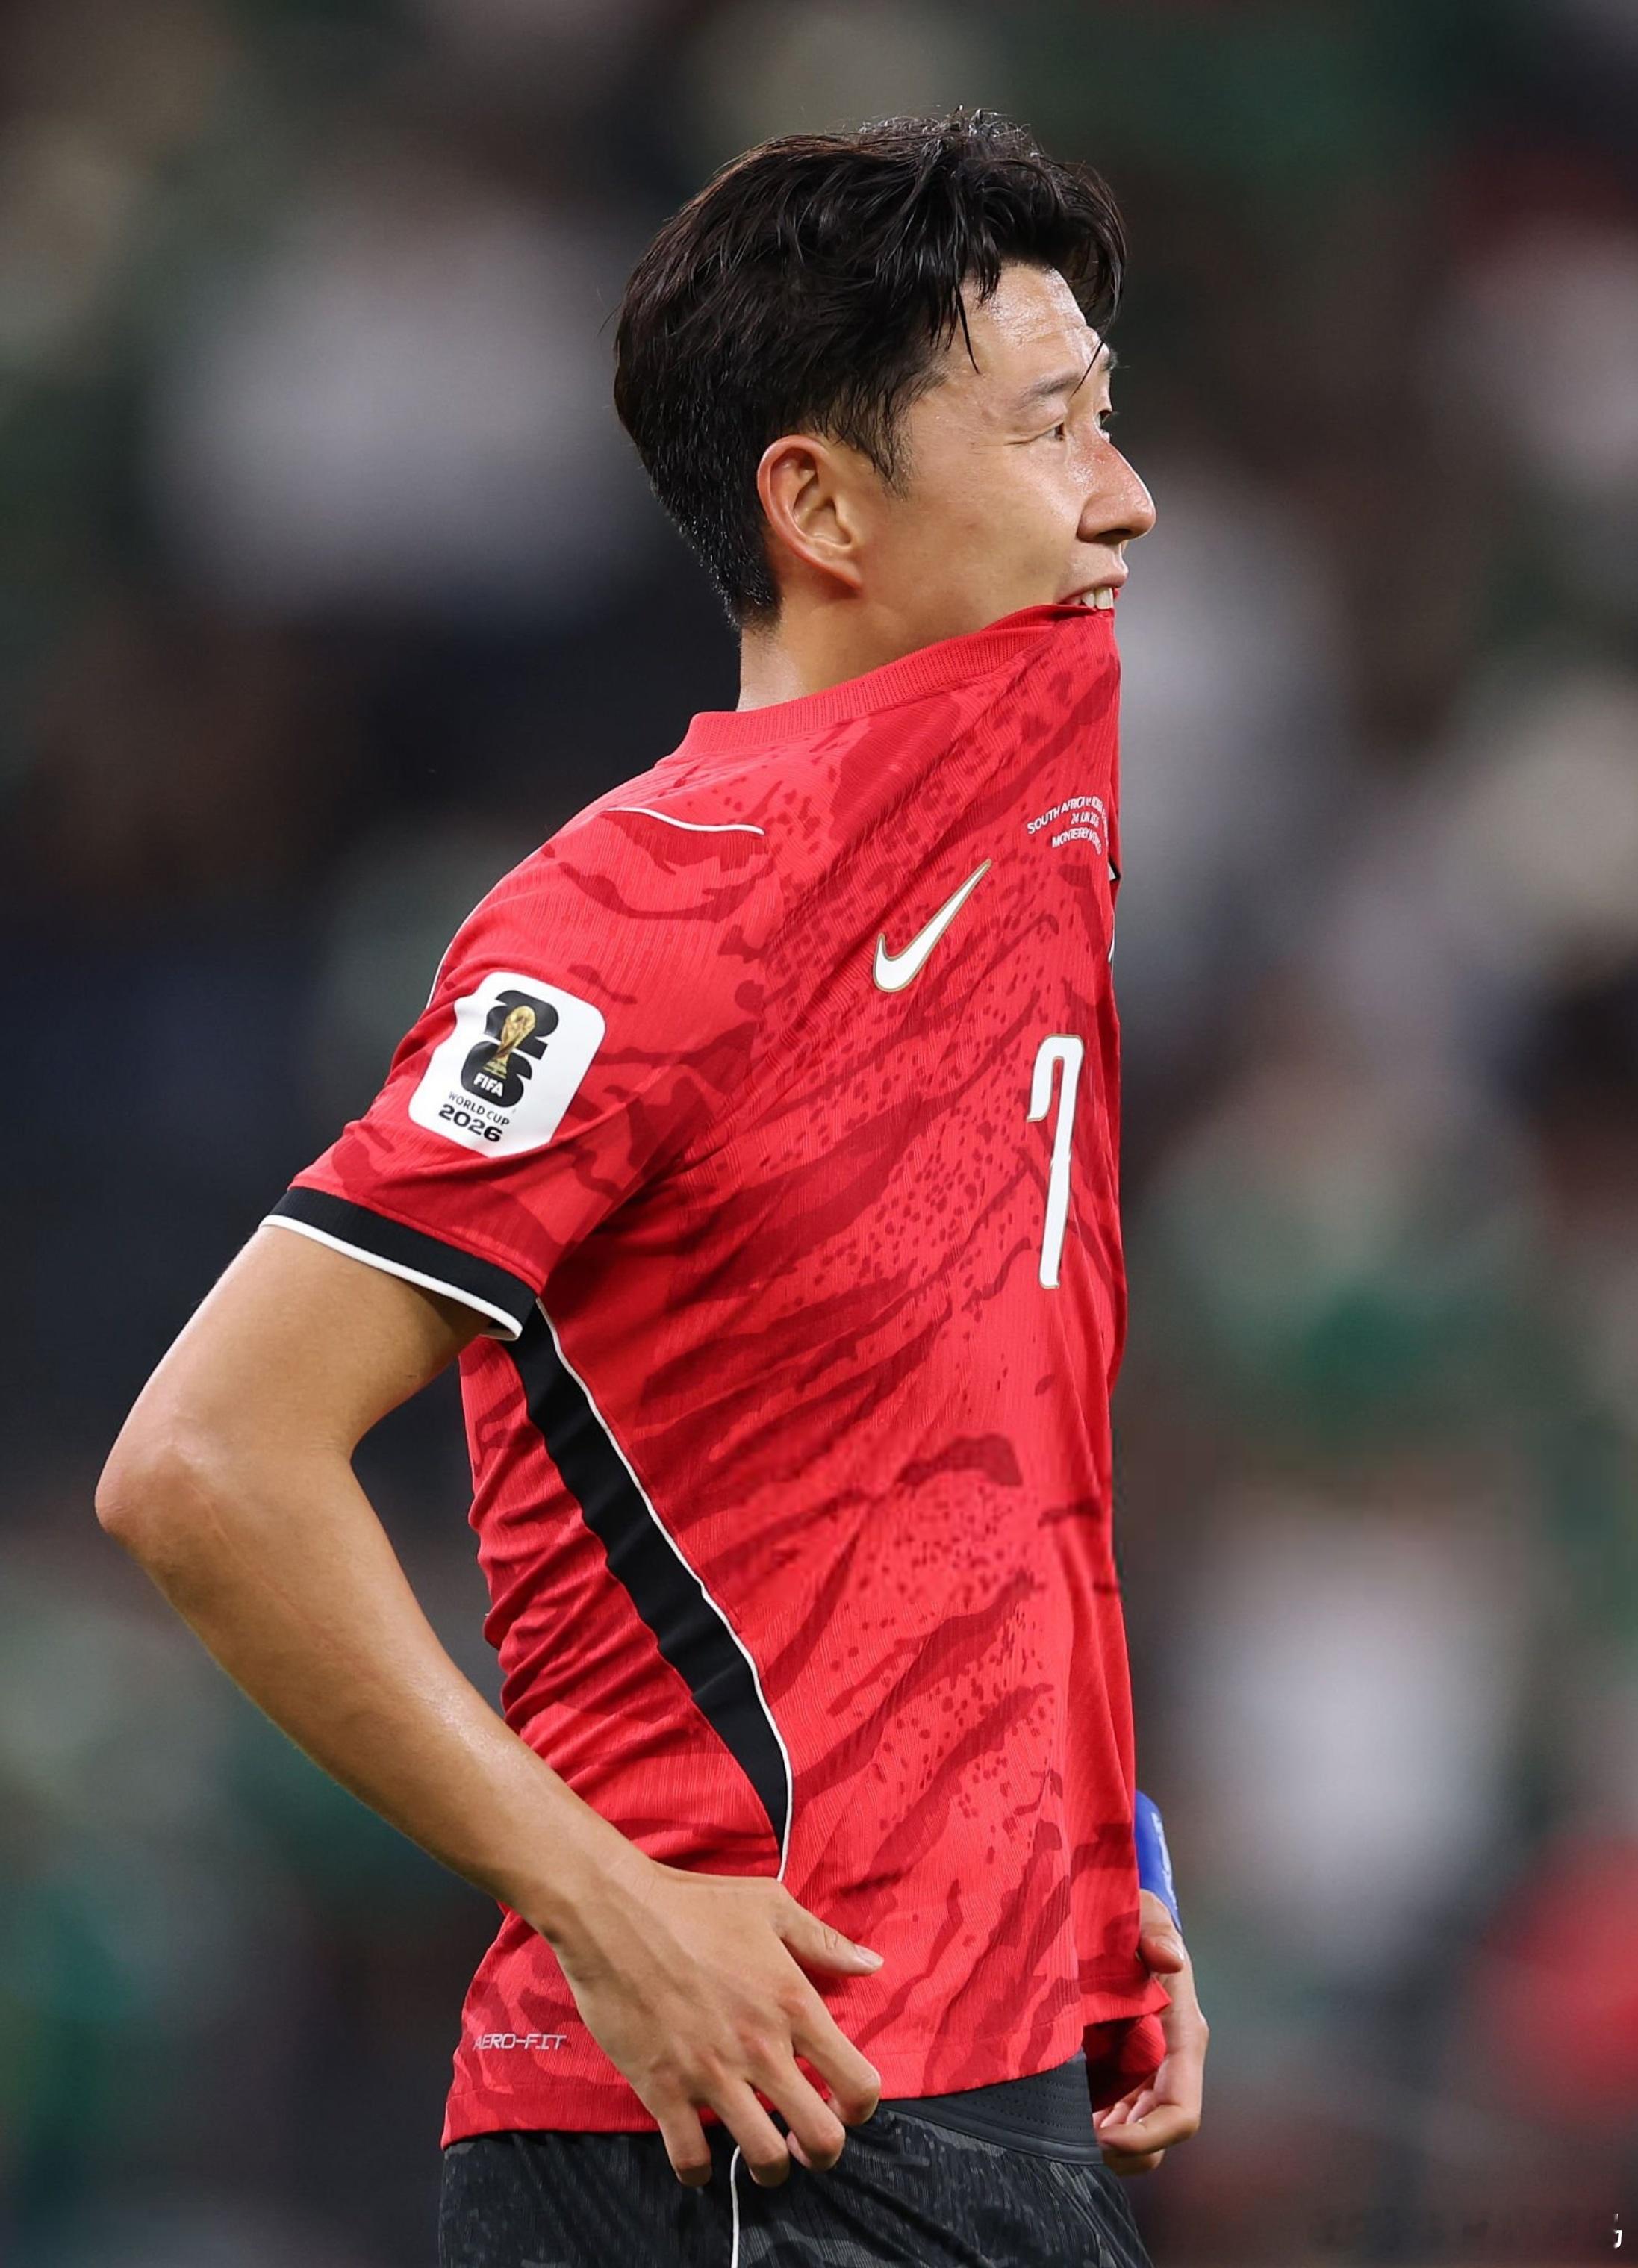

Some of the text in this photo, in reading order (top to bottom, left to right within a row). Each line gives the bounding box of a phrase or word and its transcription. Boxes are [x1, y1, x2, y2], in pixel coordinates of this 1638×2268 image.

[1027, 806, 1061, 835] SOUTH
[473, 1072, 504, 1097] FIFA
[438, 1103, 504, 1142] 2026
[448, 1091, 511, 1127] WORLD CUP
[1026, 1033, 1085, 1289] 7
[473, 2033, 567, 2051] AERO-FIT
